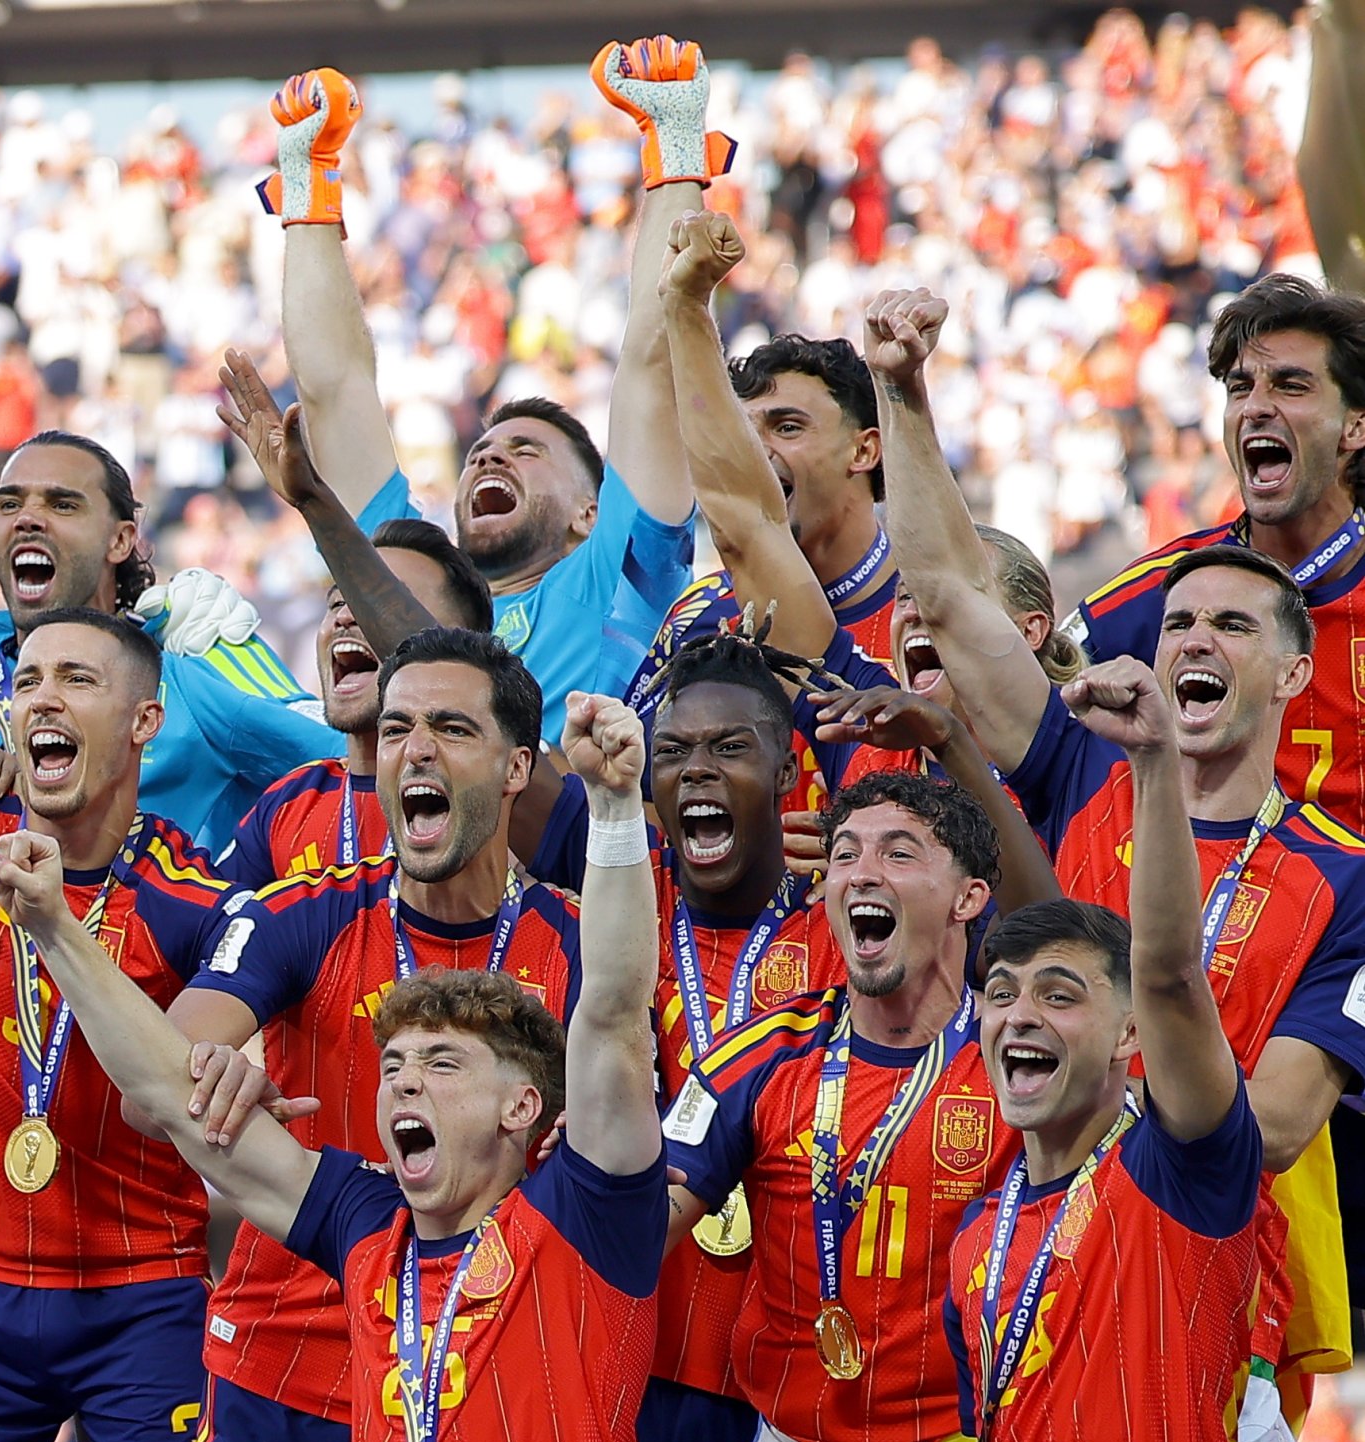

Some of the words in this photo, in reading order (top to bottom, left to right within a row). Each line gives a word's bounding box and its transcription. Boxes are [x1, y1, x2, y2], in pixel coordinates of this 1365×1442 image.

[827, 580, 854, 601] FIFA
[852, 552, 882, 582] WORLD
[1294, 563, 1316, 583] CUP
[1313, 532, 1352, 568] 2026
[1292, 729, 1333, 803] 7
[495, 918, 510, 951] FIFA
[676, 918, 686, 943] FIFA
[1204, 892, 1229, 938] 2026
[679, 944, 697, 992] WORLD
[736, 965, 751, 991] CUP
[745, 925, 771, 964] 2026
[688, 993, 703, 1018] CUP
[45, 1046, 60, 1075] CUP
[53, 1000, 71, 1046] 2026
[693, 1019, 709, 1054] 202
[1000, 1170, 1024, 1224] WORLD
[821, 1219, 833, 1252] FIFA
[857, 1184, 908, 1278] 11
[995, 1223, 1010, 1249] CUP
[402, 1274, 413, 1298] CUP
[444, 1269, 468, 1319] 2026
[986, 1249, 1003, 1302] 2026
[1023, 1253, 1047, 1311] WORLD
[402, 1298, 415, 1346] 2026
[437, 1319, 451, 1346] CUP
[1012, 1308, 1028, 1338] CUP
[427, 1347, 442, 1405] WORLD
[996, 1338, 1020, 1390] 2026
[424, 1405, 434, 1438] FIFA
